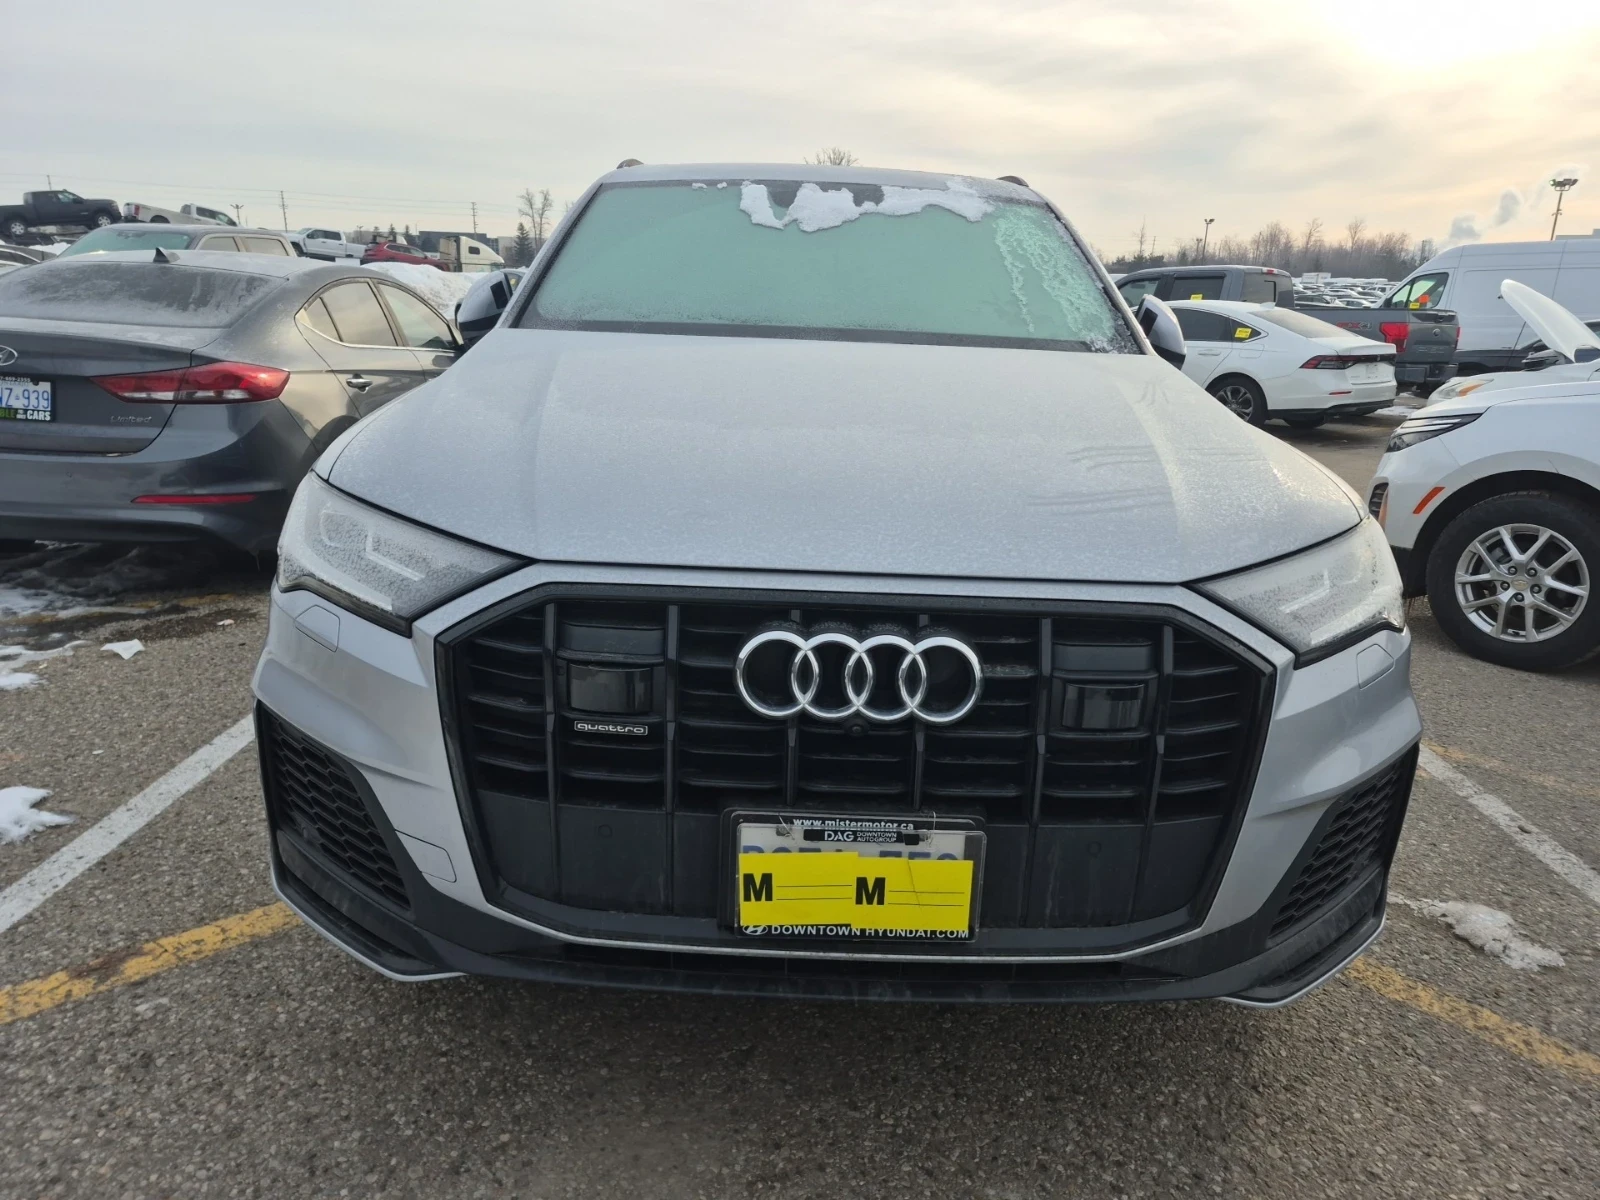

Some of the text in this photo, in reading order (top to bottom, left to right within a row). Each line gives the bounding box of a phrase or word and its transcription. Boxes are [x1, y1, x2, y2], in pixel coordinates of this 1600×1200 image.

[26, 410, 51, 421] CARS
[577, 723, 644, 734] quattro
[793, 818, 914, 831] www.mistermotor.ca
[824, 831, 854, 842] DAG
[743, 873, 773, 902] M
[855, 877, 886, 906] M
[771, 925, 969, 939] DOWNTOWN HYUNDAI.COM
